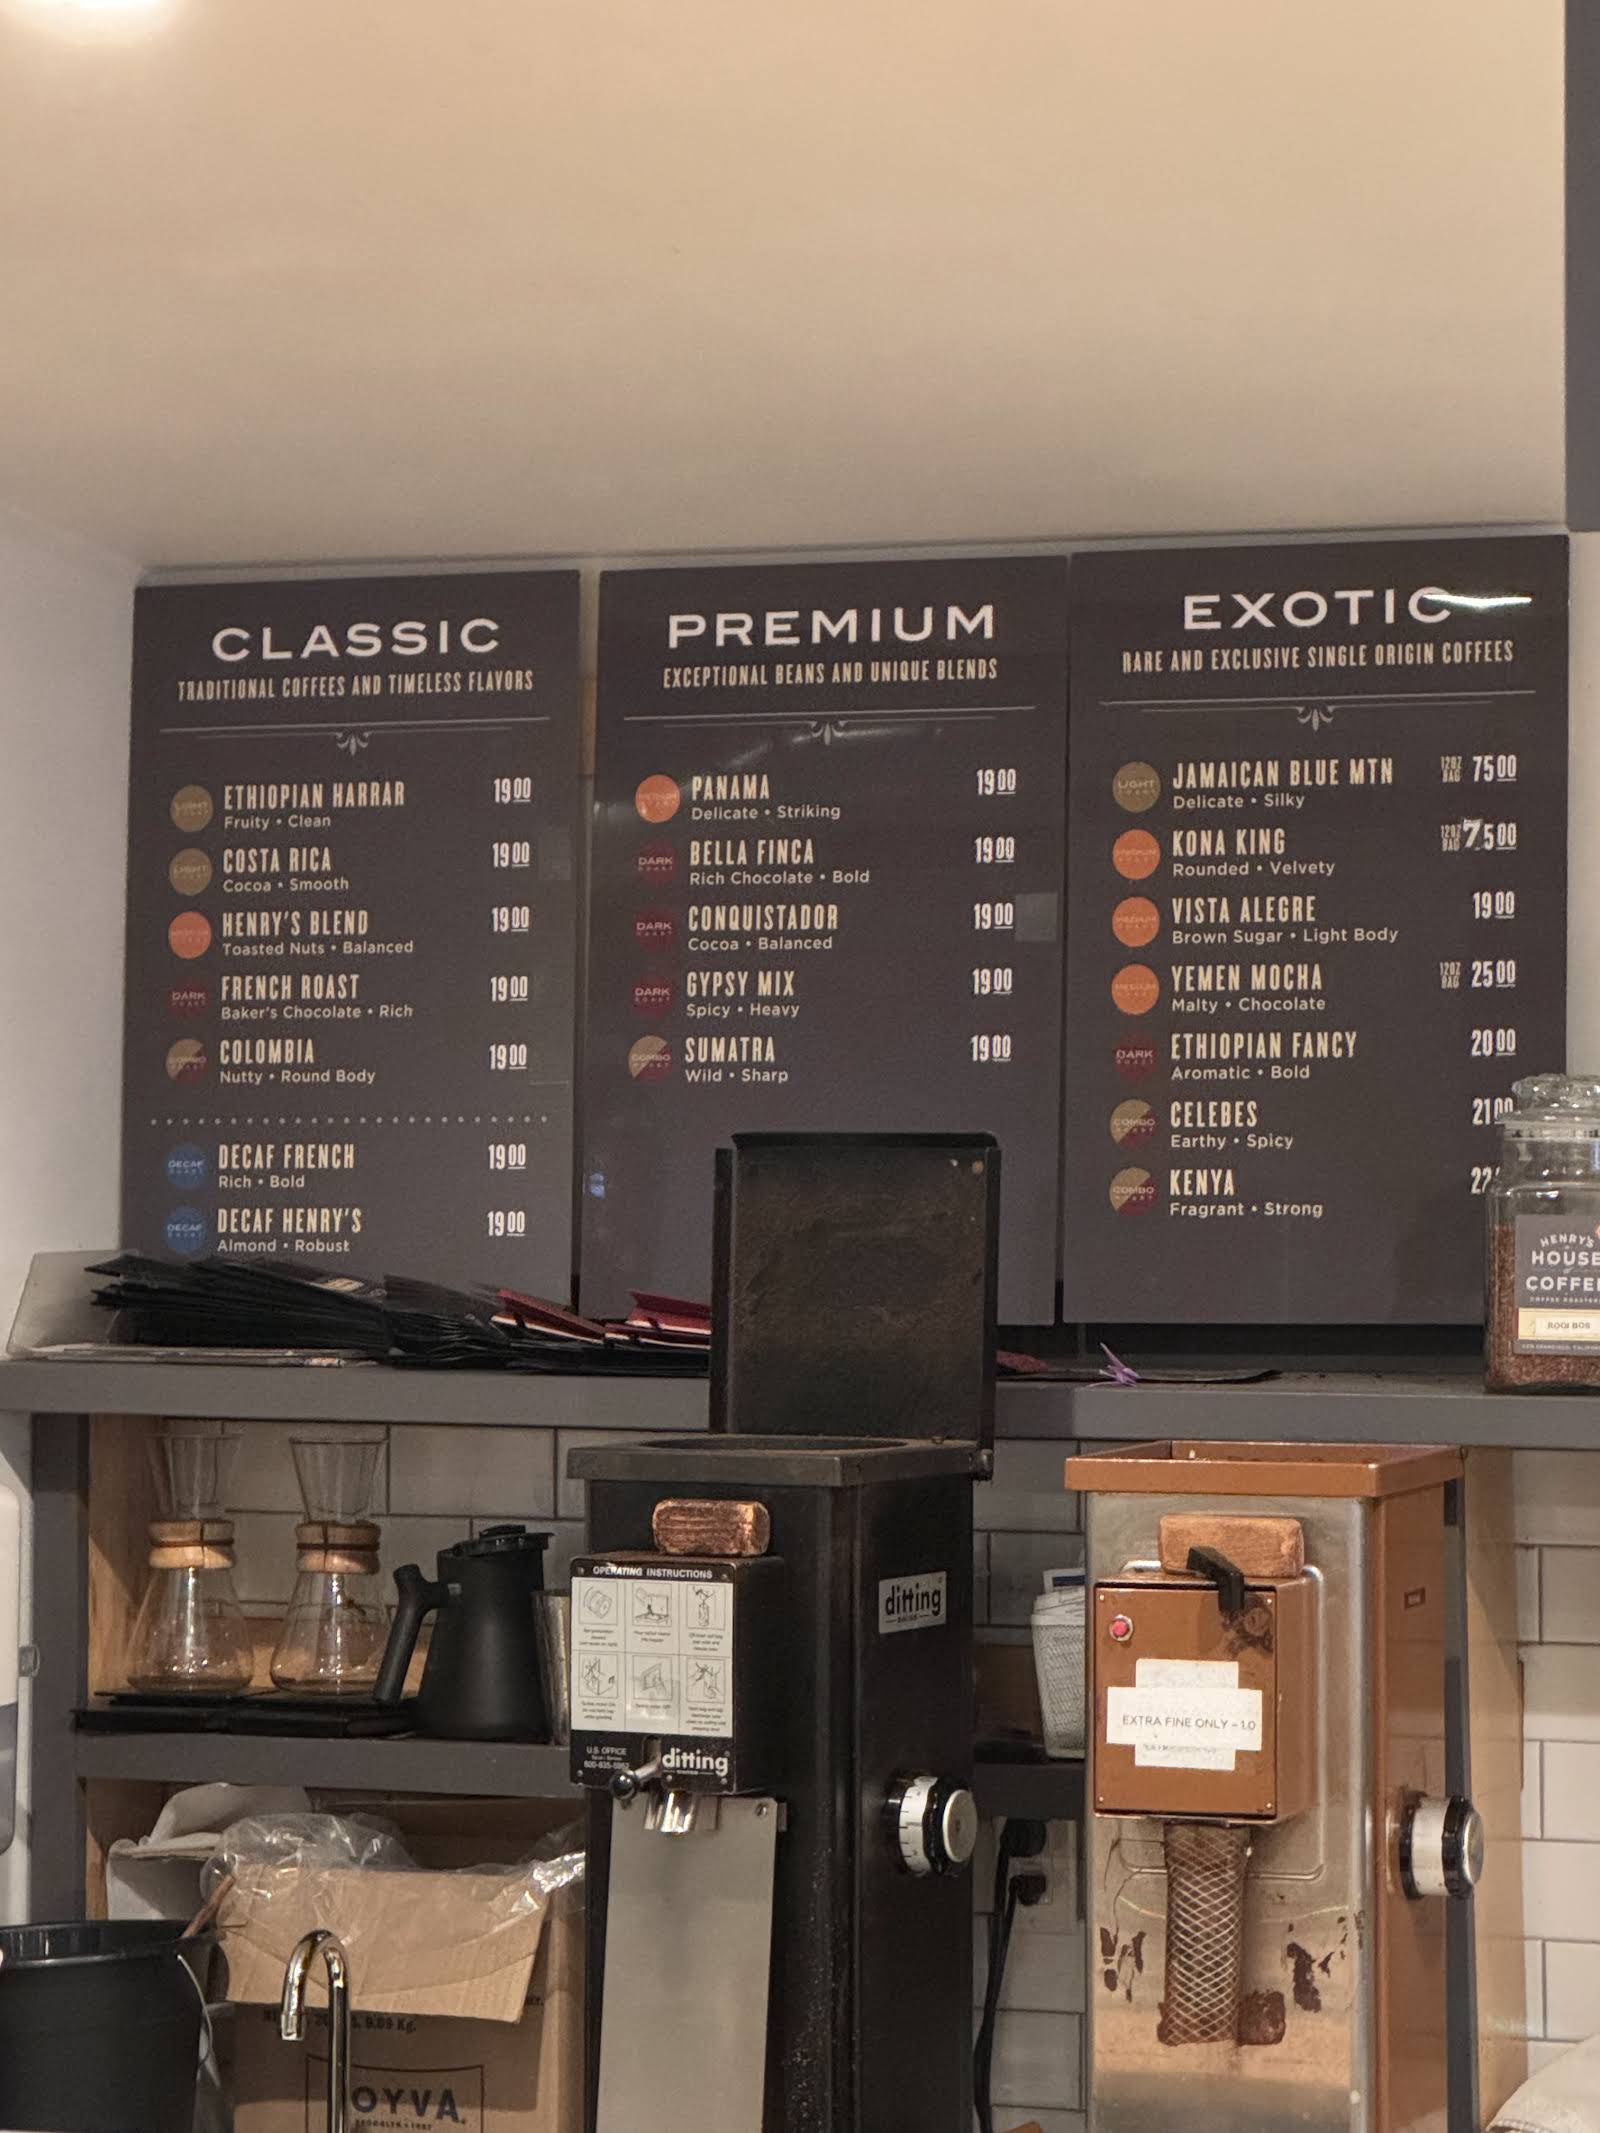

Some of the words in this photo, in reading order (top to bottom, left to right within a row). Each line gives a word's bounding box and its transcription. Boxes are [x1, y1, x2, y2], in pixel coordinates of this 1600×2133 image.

[1183, 585, 1453, 631] EXOTIC
[669, 605, 993, 648] PREMIUM
[213, 619, 498, 661] CLASSIC
[1123, 651, 1162, 673] RARE
[1171, 650, 1202, 671] AND
[1212, 647, 1299, 670] EXCLUSIVE
[1308, 645, 1366, 667] SINGLE
[1375, 643, 1433, 665] ORIGIN
[1443, 640, 1513, 664] COFFEES
[179, 678, 275, 701] TRADITIONAL
[283, 676, 345, 697] COFFEES
[352, 675, 381, 695] AND
[389, 672, 461, 694] TIMELESS
[469, 670, 532, 691] FLAVORS
[664, 665, 767, 688] EXCEPTIONAL
[776, 663, 824, 684] BEANS
[832, 662, 862, 683] AND
[871, 660, 929, 682] UNIQUE
[937, 658, 997, 680] BLENDS
[1173, 761, 1278, 789] JAMAICAN
[1290, 760, 1338, 786] BLUE
[1350, 758, 1392, 784] MTN
[225, 784, 322, 810] ETHIOPIAN
[333, 781, 404, 807] HARRAR
[692, 775, 769, 800] PANAMA
[692, 807, 758, 820] Delicate
[777, 805, 840, 820] Striking
[1174, 795, 1243, 809] Delicate
[1264, 793, 1304, 809] Silky
[225, 816, 269, 831] Fruity
[288, 815, 331, 828] Clean
[690, 840, 747, 865] BELLA
[758, 839, 813, 865] FINCA
[1173, 830, 1225, 856] KONA
[1237, 828, 1284, 855] KING
[224, 848, 280, 873] COSTA
[290, 847, 331, 872] RICA
[639, 856, 672, 866] DARK
[1173, 862, 1248, 876] Rounded
[1270, 861, 1335, 876] Velvety
[223, 879, 271, 892] Cocoa
[290, 877, 348, 891] Smooth
[690, 872, 724, 885] Rich
[731, 871, 813, 884] Chocolate
[833, 870, 869, 883] Bold
[689, 904, 837, 931] CONQUISTADOR
[1172, 897, 1229, 923] VISTA
[1240, 896, 1315, 922] ALEGRE
[223, 911, 300, 937] HENRY'S
[310, 910, 367, 935] BLEND
[637, 921, 672, 931] DARK
[223, 942, 284, 955] Toasted
[290, 942, 324, 954] Nuts
[343, 940, 413, 954] Balanced
[688, 938, 738, 951] Cocoa
[759, 936, 832, 950] Balanced
[1173, 931, 1226, 944] Brown
[1234, 930, 1283, 945] Sugar
[1304, 928, 1347, 944] Light
[1354, 928, 1398, 943] Body
[222, 975, 291, 1000] FRENCH
[302, 974, 359, 999] ROAST
[687, 971, 748, 997] GYPSY
[758, 971, 794, 996] MIX
[1172, 965, 1239, 992] YEMEN
[1252, 964, 1321, 990] MOCHA
[635, 987, 670, 997] DARK
[222, 1007, 277, 1020] Baker's
[283, 1005, 361, 1018] Chocolate
[380, 1004, 413, 1017] Rich
[687, 1003, 730, 1018] Spicy
[750, 1003, 799, 1017] Heavy
[1172, 998, 1218, 1014] Malty
[1239, 997, 1325, 1011] Chocolate
[220, 1039, 314, 1064] COLOMBIA
[685, 1037, 774, 1062] SUMATRA
[1116, 1050, 1153, 1059] DARK
[1172, 1032, 1281, 1060] ETHIOPIAN
[1293, 1032, 1356, 1058] FANCY
[220, 1071, 262, 1085] Nutty
[281, 1070, 330, 1083] Round
[336, 1069, 375, 1084] Body
[685, 1069, 722, 1082] Wild
[742, 1068, 788, 1083] Sharp
[1172, 1066, 1250, 1080] Aromatic
[1271, 1065, 1309, 1078] Bold
[1171, 1101, 1257, 1127] CELEBES
[1171, 1134, 1226, 1150] Earthy
[1247, 1133, 1293, 1150] Spicy
[219, 1144, 274, 1169] DECAF
[284, 1144, 354, 1169] FRENCH
[219, 1175, 251, 1188] Rich
[270, 1175, 304, 1188] Bold
[1170, 1169, 1234, 1195] KENYA
[1471, 1166, 1500, 1194] 22
[218, 1208, 273, 1233] DECAF
[283, 1208, 361, 1233] HENRY'S
[1170, 1203, 1244, 1218] Fragrant
[1264, 1202, 1322, 1218] Strong
[218, 1239, 276, 1252] Almond
[295, 1239, 349, 1252] Robust
[1540, 1234, 1594, 1248] HENRY'S
[1531, 1251, 1600, 1266] HOUSE
[593, 1566, 642, 1577] OPERATING
[646, 1568, 713, 1579] INSTRUCTIONS
[885, 1583, 941, 1616] ditting
[1123, 1715, 1163, 1727] EXTRA
[1165, 1717, 1191, 1728] FINE
[1195, 1718, 1229, 1729] ONLY
[662, 1748, 729, 1777] ditting
[352, 2086, 461, 2123] OYVA
